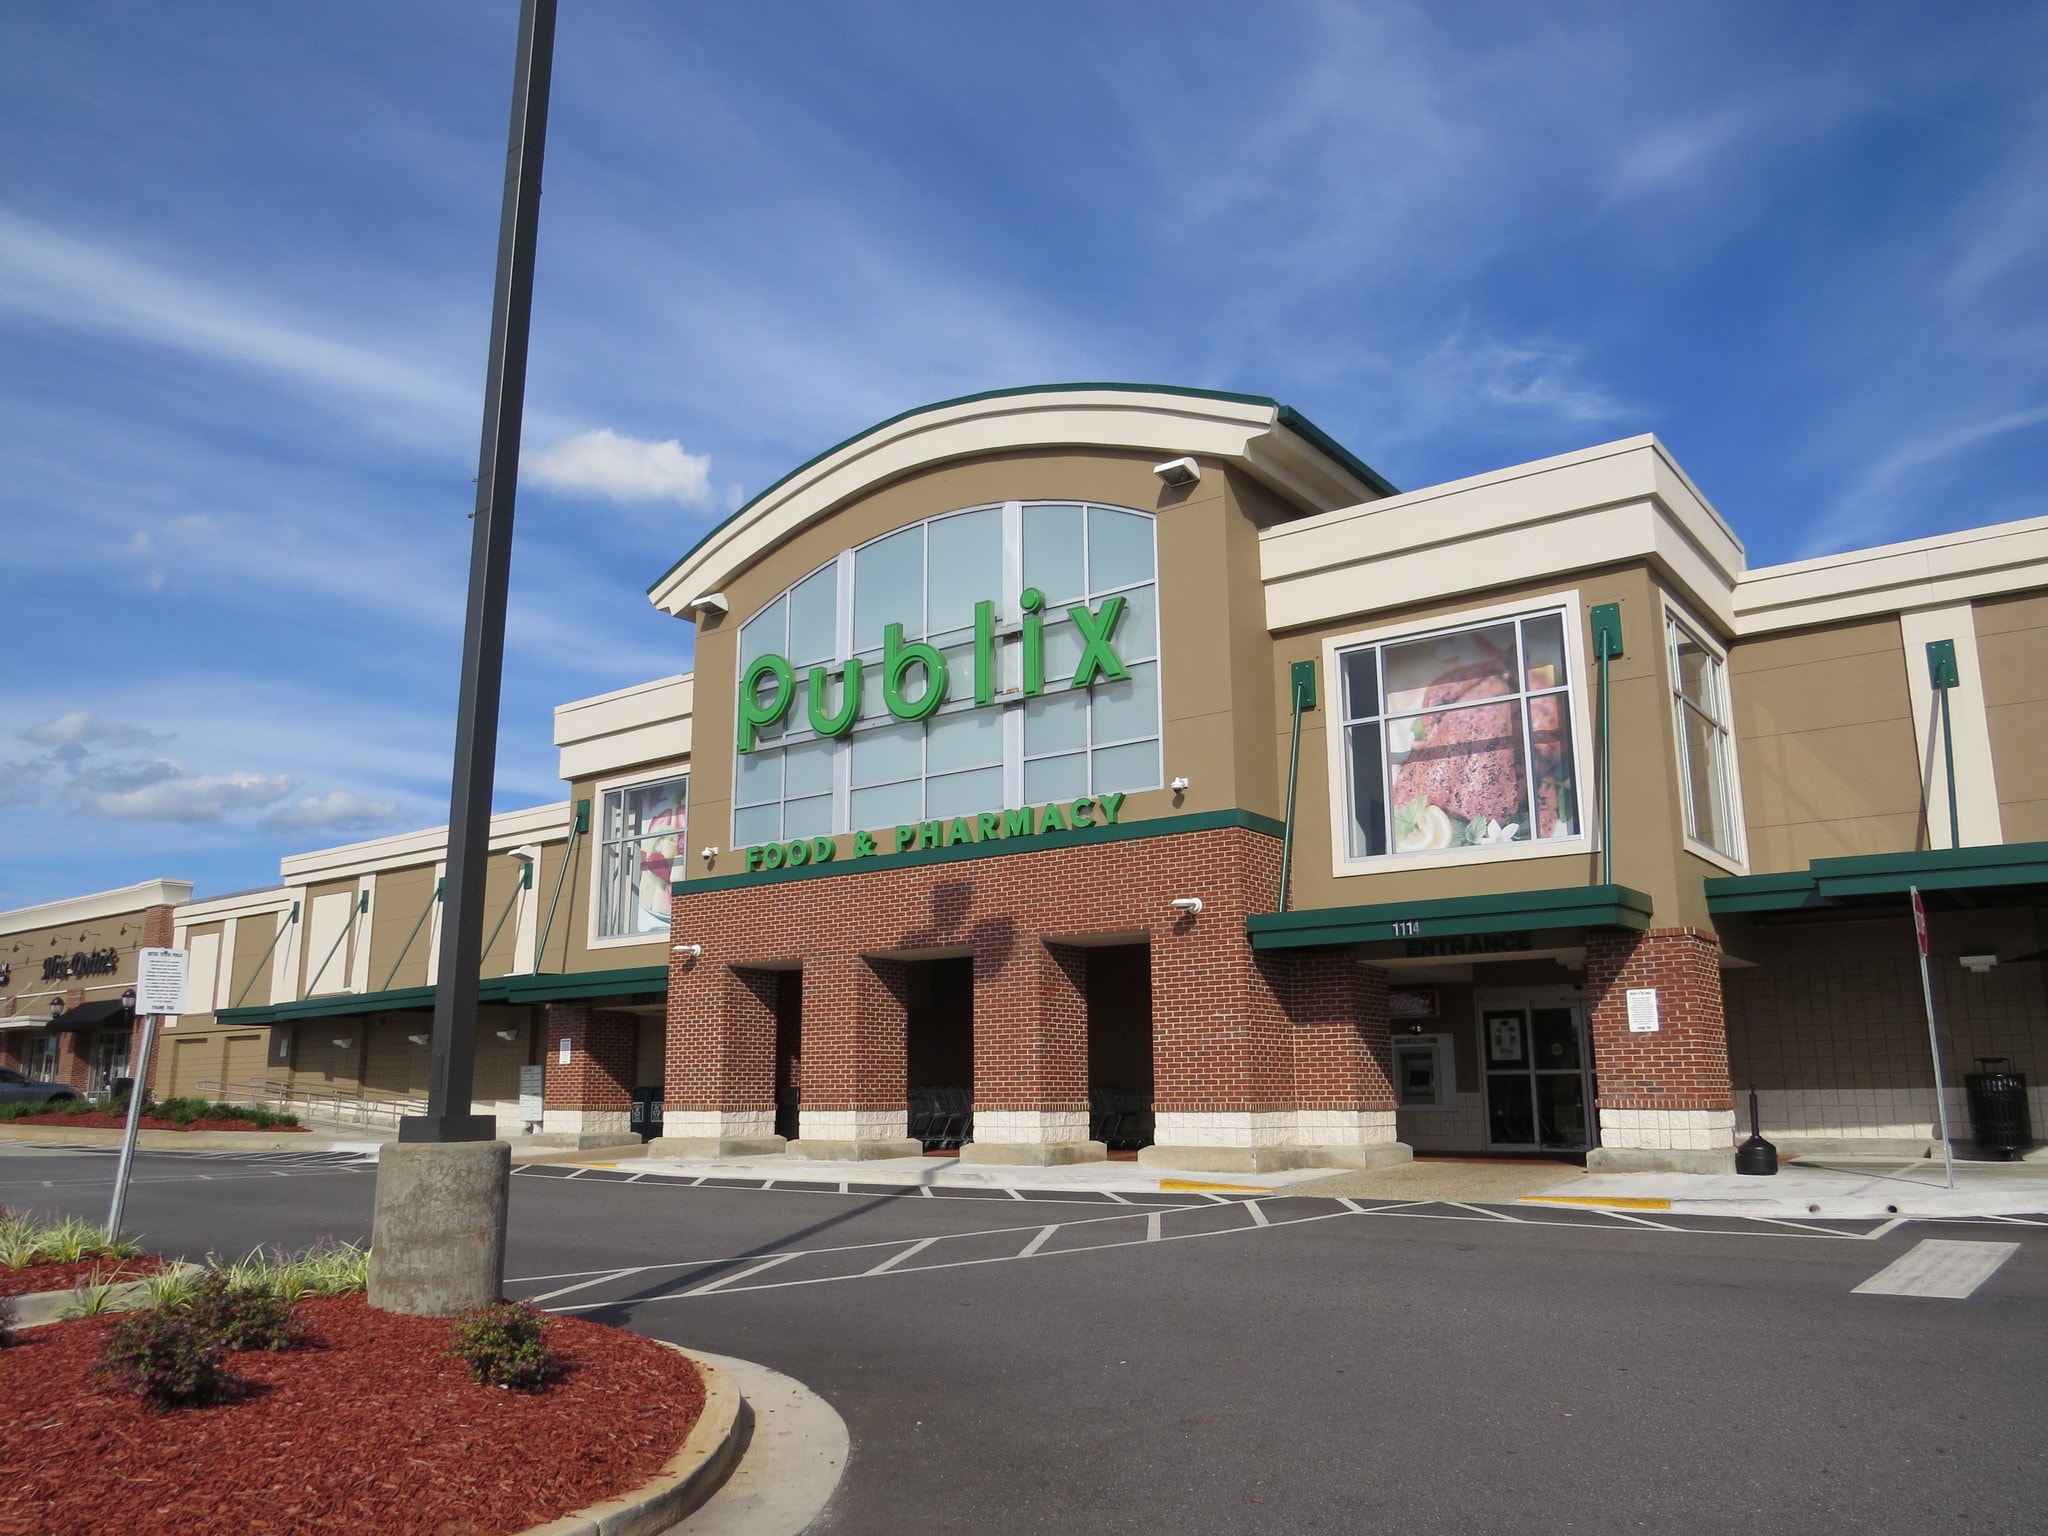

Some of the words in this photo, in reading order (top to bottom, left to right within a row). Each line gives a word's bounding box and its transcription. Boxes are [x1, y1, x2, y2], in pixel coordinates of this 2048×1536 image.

[737, 587, 1132, 755] Publix
[745, 836, 837, 872] FOOD
[852, 830, 878, 858] &
[895, 792, 1127, 852] PHARMACY
[1392, 920, 1420, 937] 1114
[1406, 932, 1533, 958] ENTRANCE
